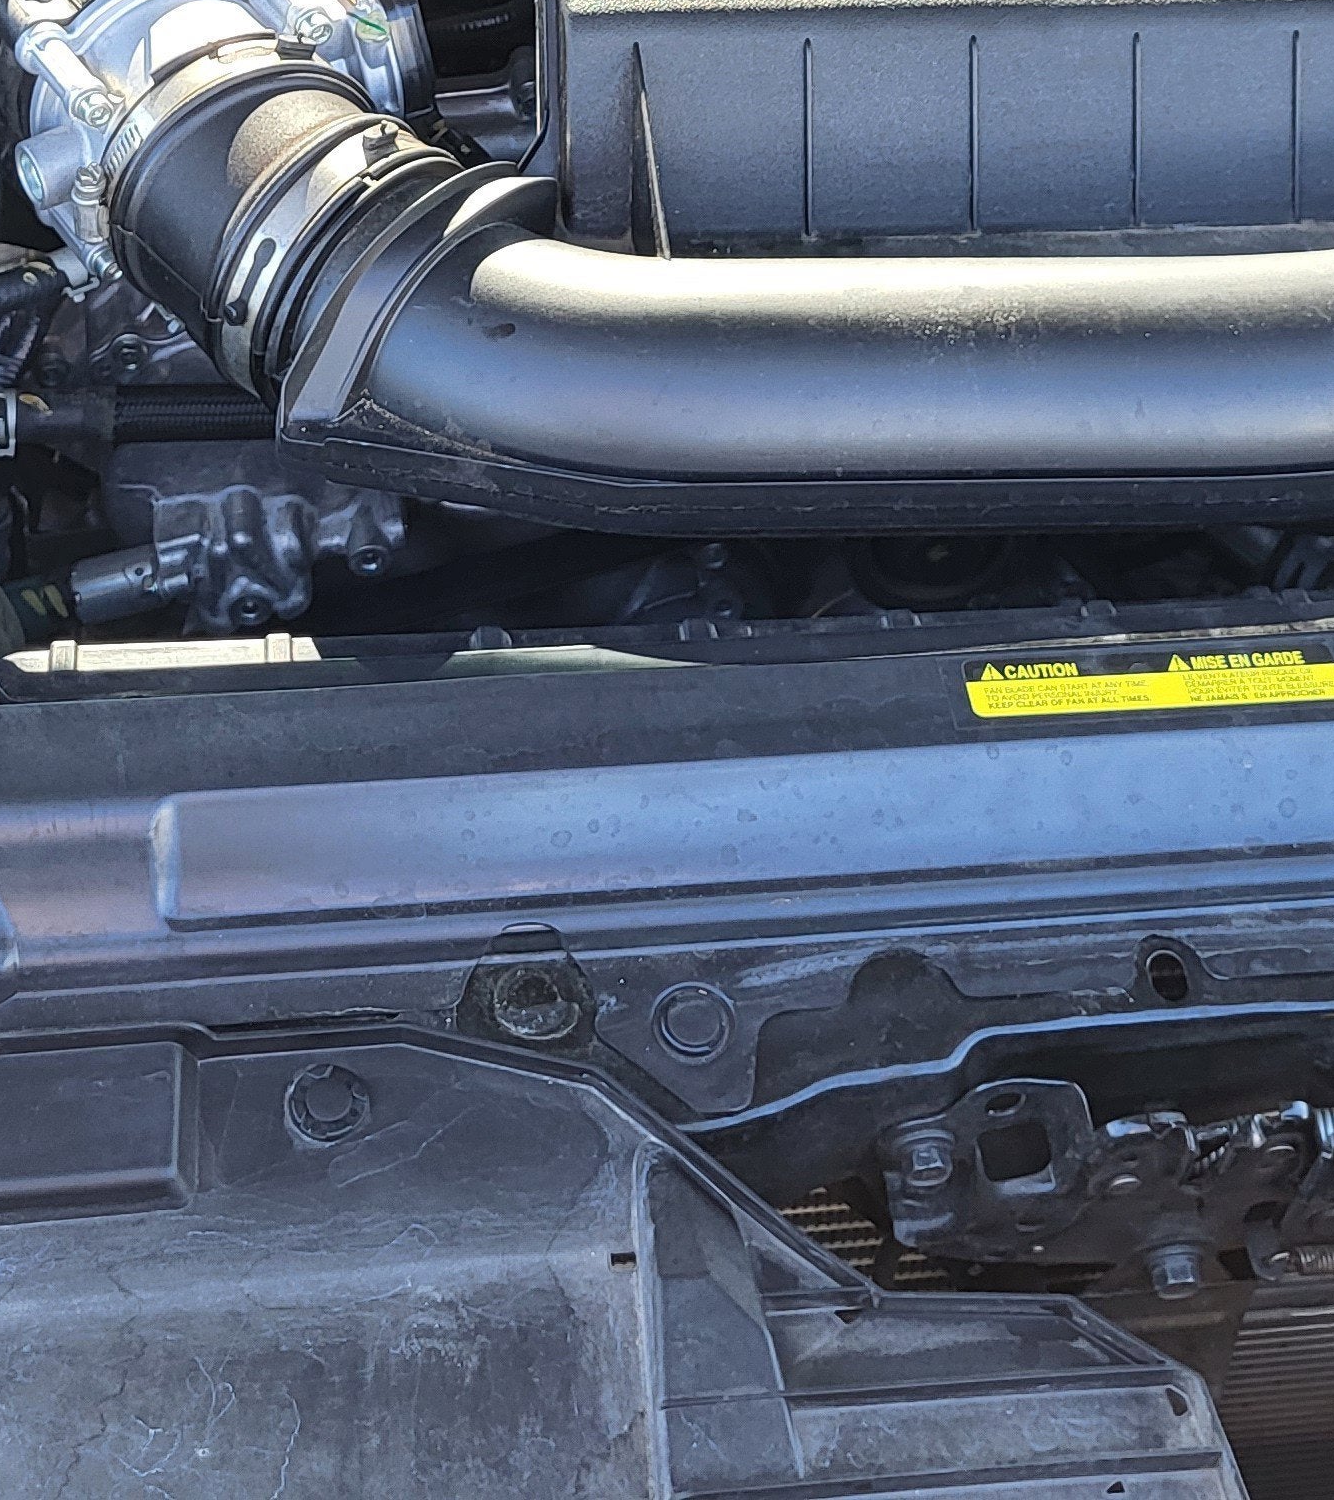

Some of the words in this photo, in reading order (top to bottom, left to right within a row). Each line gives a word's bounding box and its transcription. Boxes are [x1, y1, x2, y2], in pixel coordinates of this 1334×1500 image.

[1189, 655, 1228, 670] MISE
[1228, 654, 1251, 668] EN
[1251, 651, 1306, 666] GARDE
[1004, 663, 1079, 679] CAUTION
[988, 701, 1014, 710] KEEP
[1016, 699, 1048, 708] CLEAR
[1051, 698, 1063, 706] OF
